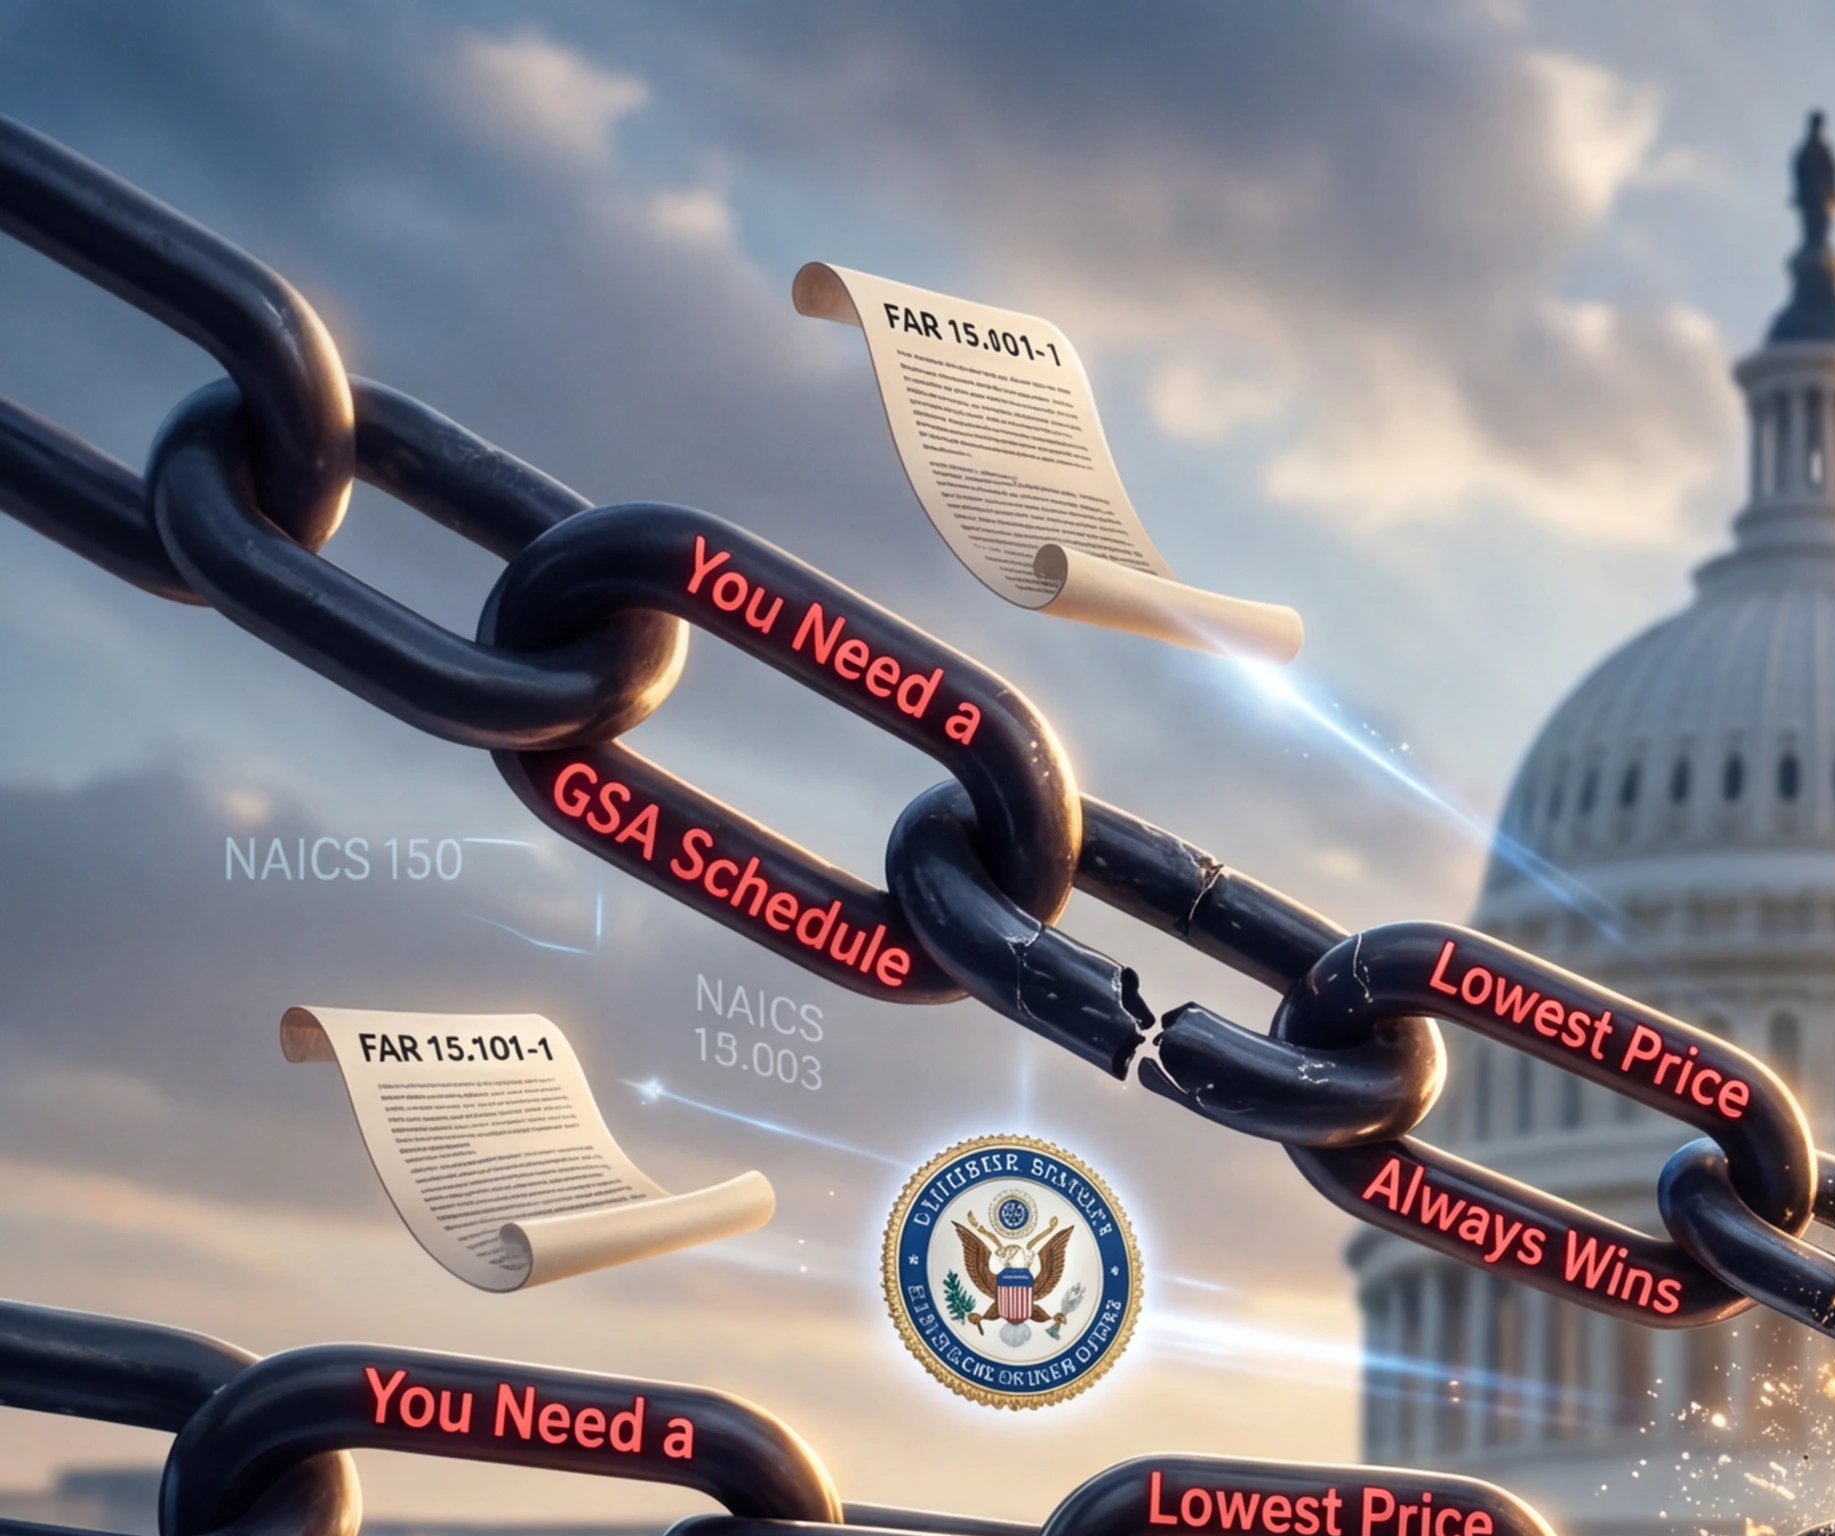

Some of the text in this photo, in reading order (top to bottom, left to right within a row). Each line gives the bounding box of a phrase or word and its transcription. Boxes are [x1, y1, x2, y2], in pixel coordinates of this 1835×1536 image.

[884, 303, 943, 340] FAR
[688, 537, 980, 744] You Need a
[225, 837, 463, 881] NAICS 150
[554, 763, 910, 986] GSA Schedule
[697, 973, 823, 1042] NAICS
[1430, 942, 1749, 1117] Lowest Price
[359, 1033, 554, 1062] FAR 15.101-1
[1363, 1159, 1681, 1313] Always Wins
[366, 1368, 693, 1458] You Need a
[1150, 1472, 1342, 1536] Lowest
